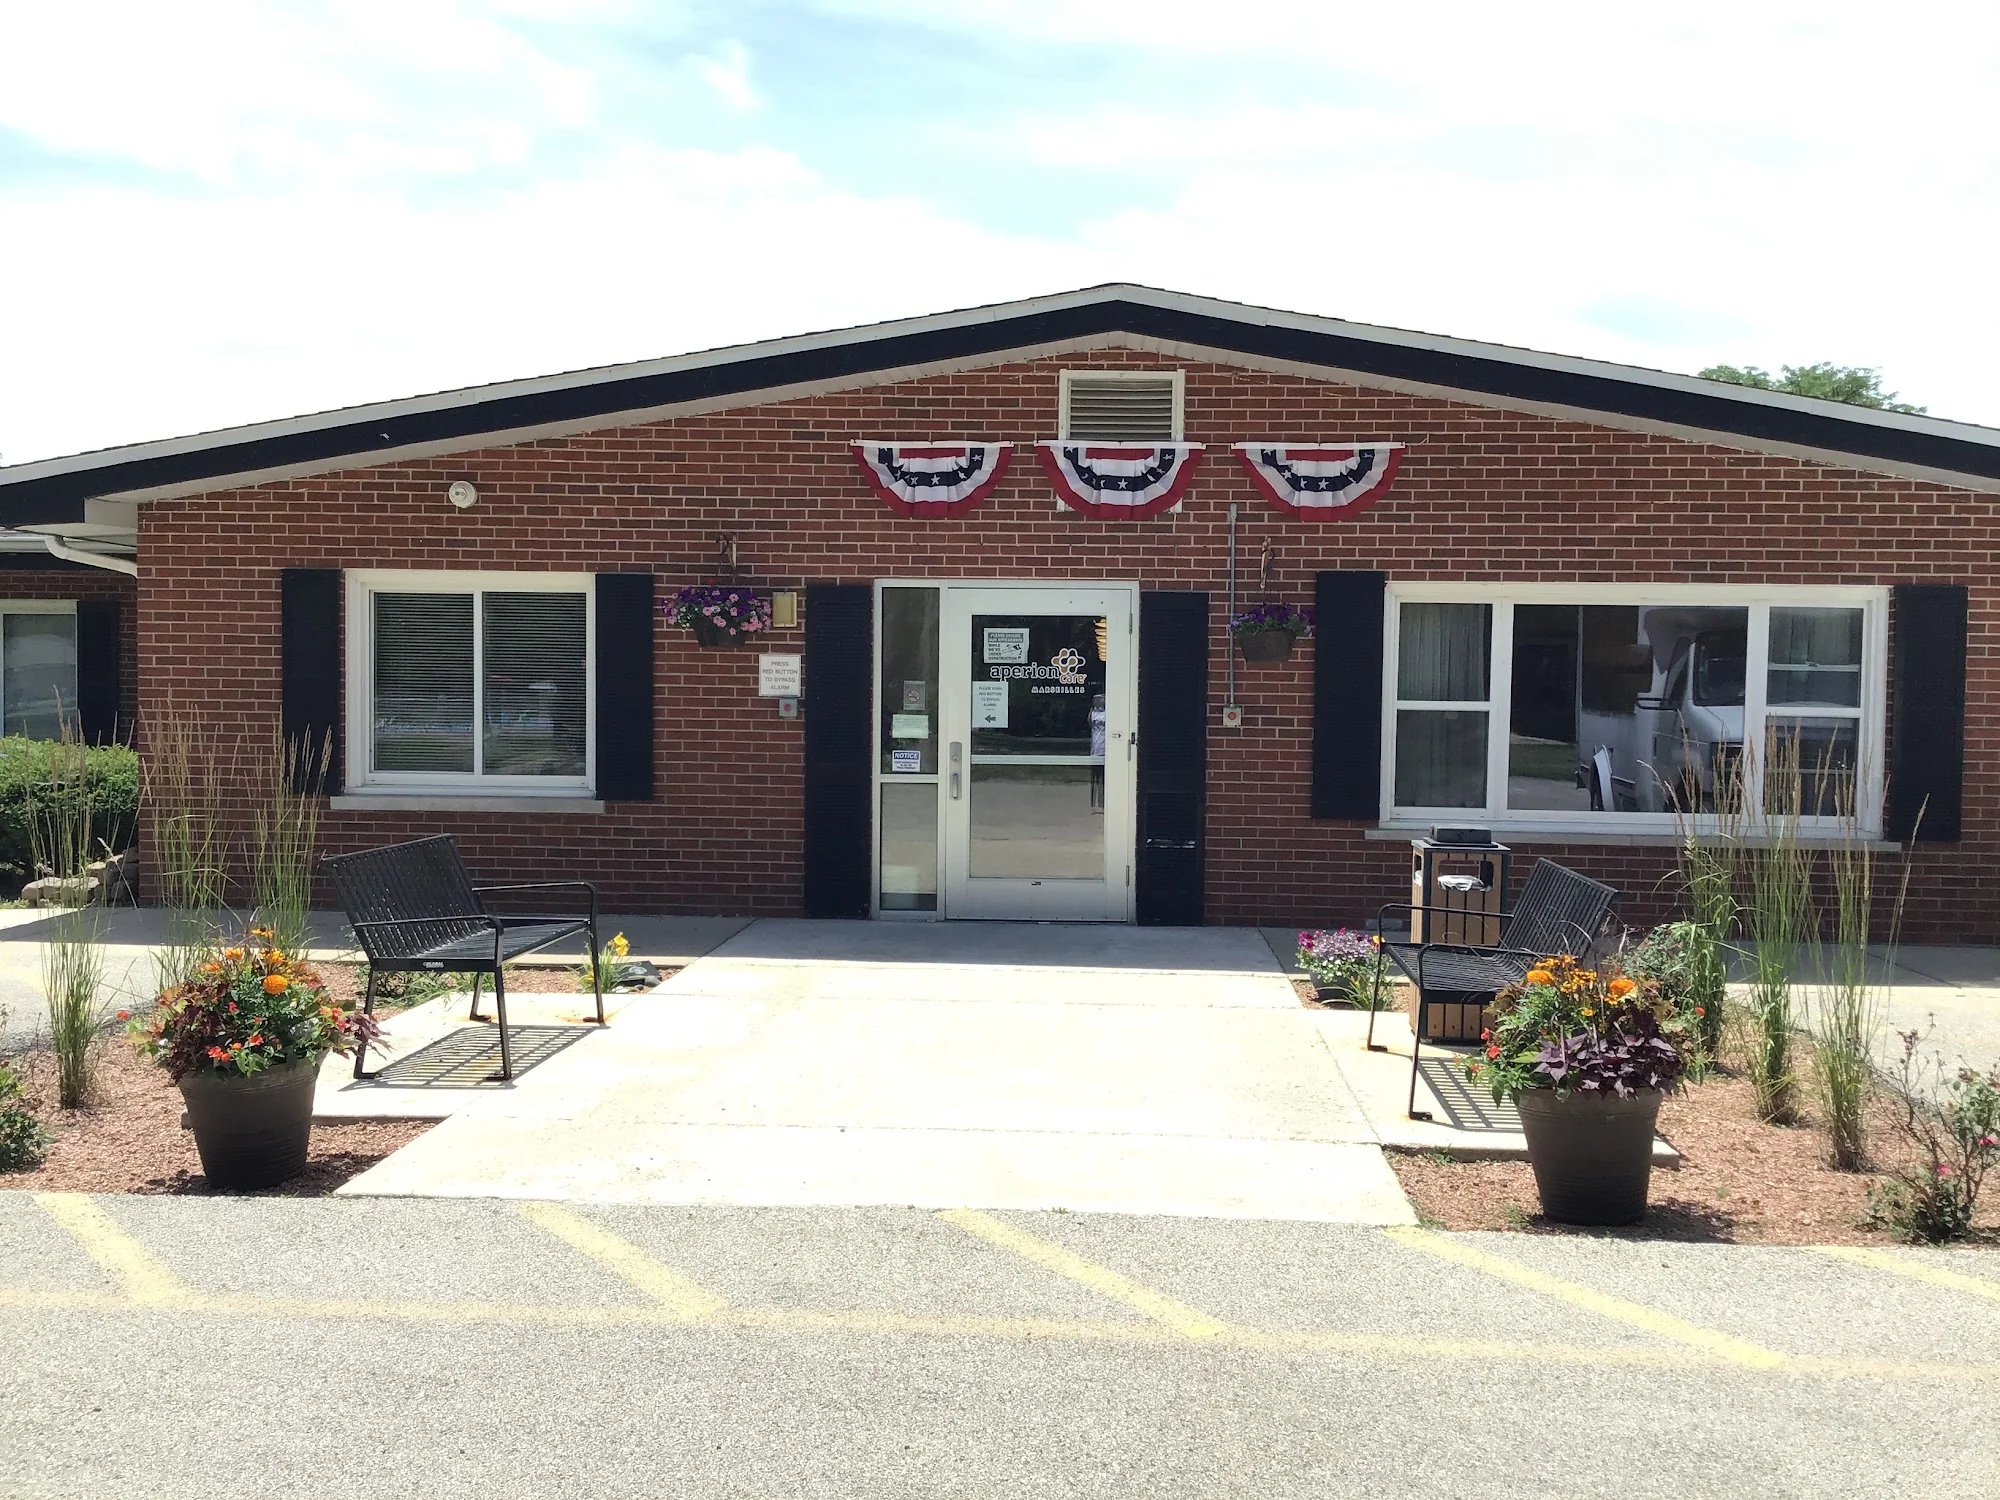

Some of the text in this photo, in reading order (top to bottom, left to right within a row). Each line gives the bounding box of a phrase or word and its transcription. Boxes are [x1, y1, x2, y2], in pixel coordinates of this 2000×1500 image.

[990, 662, 1060, 682] aperion
[1060, 674, 1085, 684] care
[1031, 686, 1086, 694] MARSEILLES
